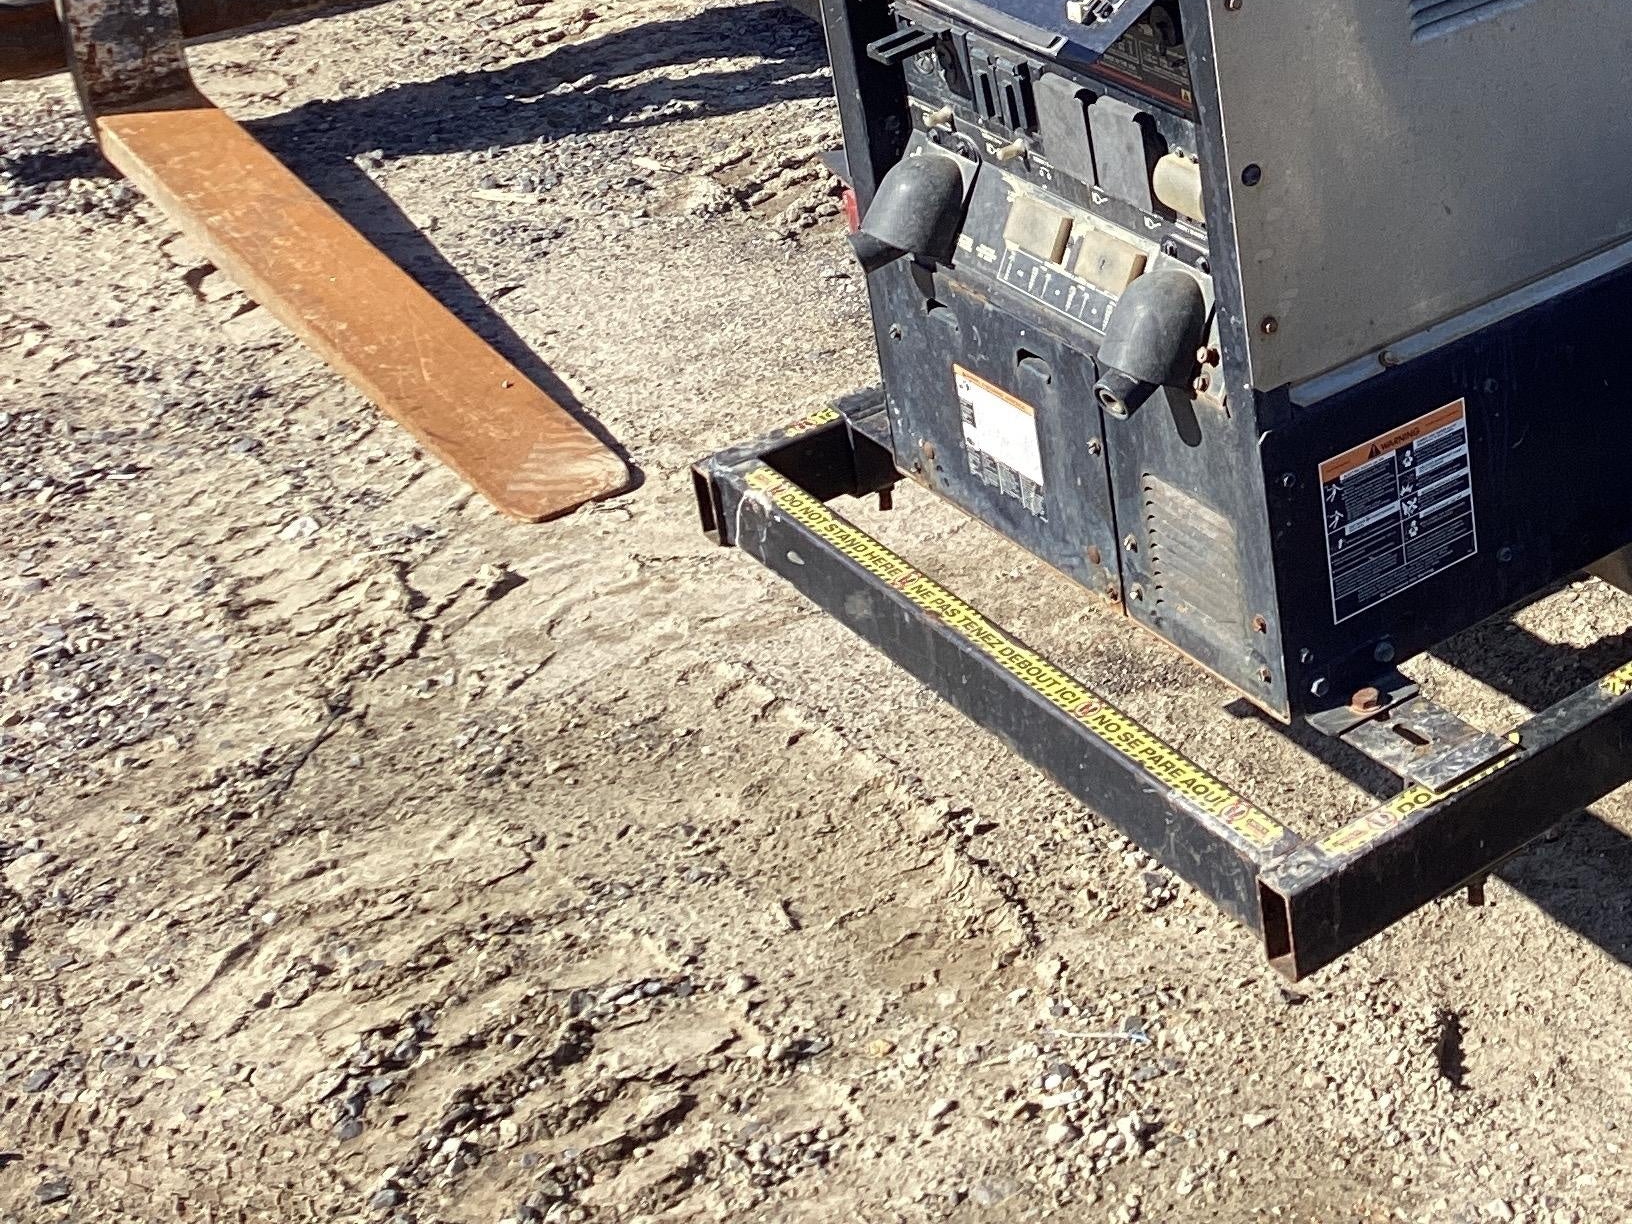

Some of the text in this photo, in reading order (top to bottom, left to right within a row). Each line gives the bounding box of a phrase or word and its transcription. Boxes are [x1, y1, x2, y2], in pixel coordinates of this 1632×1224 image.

[780, 492, 904, 578] DO NOT STAND HERE
[913, 581, 1082, 704] NE PAS TENEZ DEBOUT ICI
[1093, 707, 1121, 735] NO
[1118, 726, 1147, 751] SE
[1138, 744, 1185, 782] PARE
[1395, 791, 1433, 816] DO
